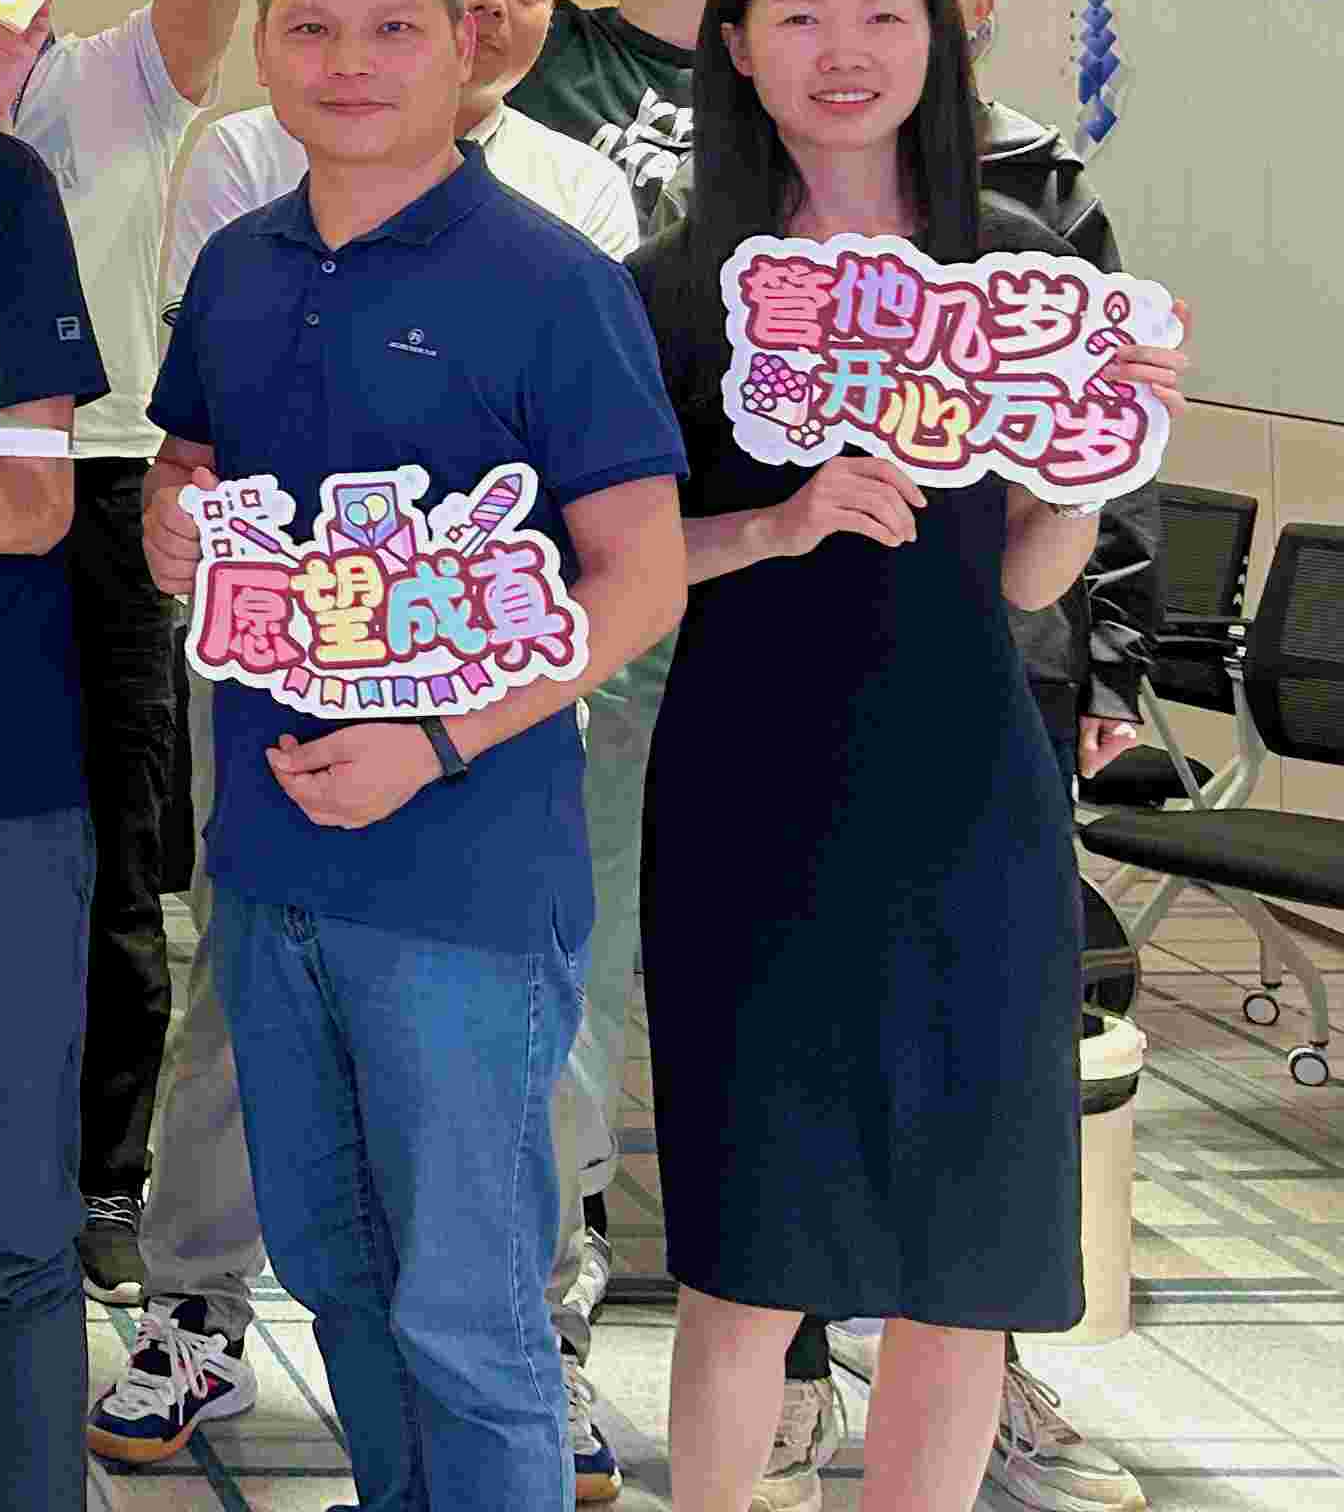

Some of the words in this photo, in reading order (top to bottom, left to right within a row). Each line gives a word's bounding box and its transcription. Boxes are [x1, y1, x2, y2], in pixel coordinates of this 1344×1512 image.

[739, 252, 1088, 377] 管他几岁
[810, 348, 1148, 486] 开心万岁
[197, 540, 574, 674] 愿望成真
